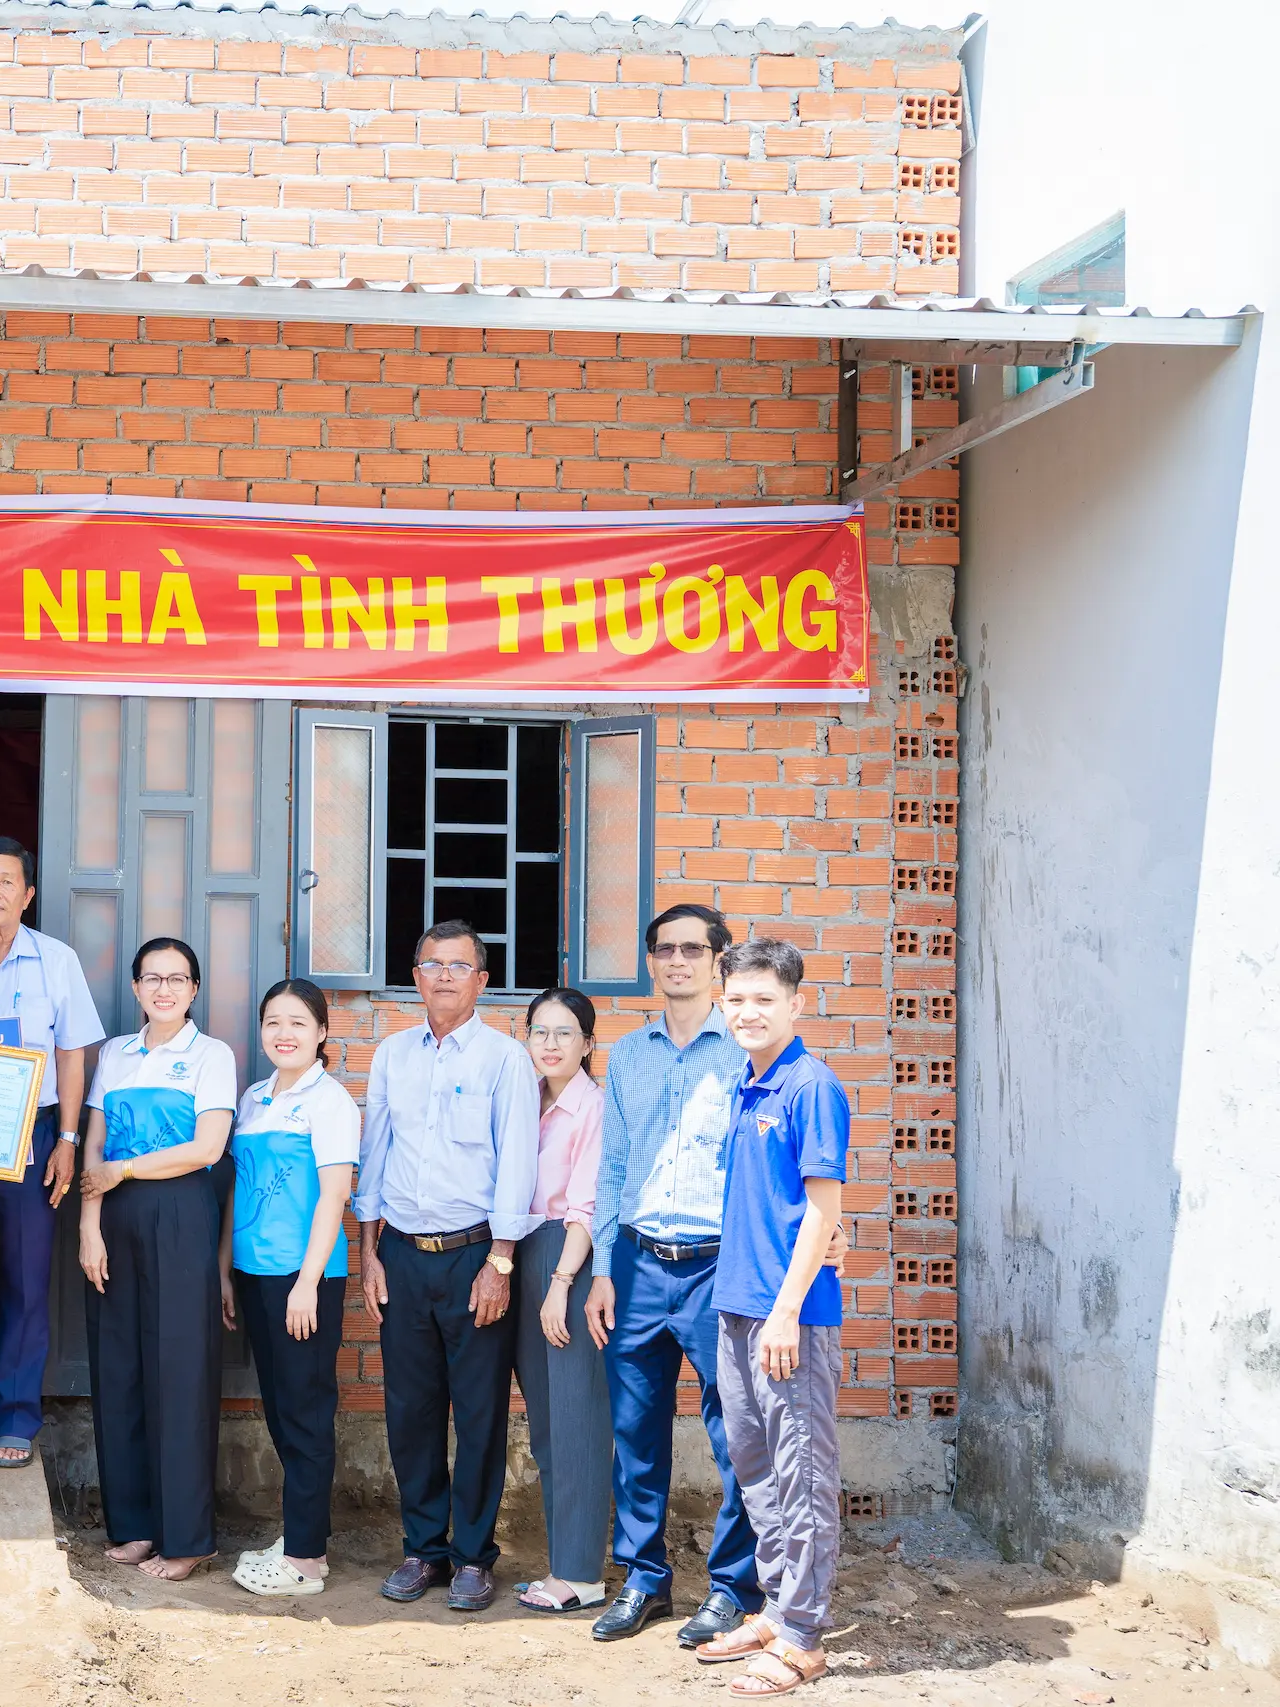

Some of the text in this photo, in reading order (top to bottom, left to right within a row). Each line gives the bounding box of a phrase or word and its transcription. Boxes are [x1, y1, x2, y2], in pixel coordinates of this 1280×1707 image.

[22, 548, 207, 645] NHÀ
[238, 554, 448, 652] TÌNH
[481, 562, 838, 656] THƯƠNG
